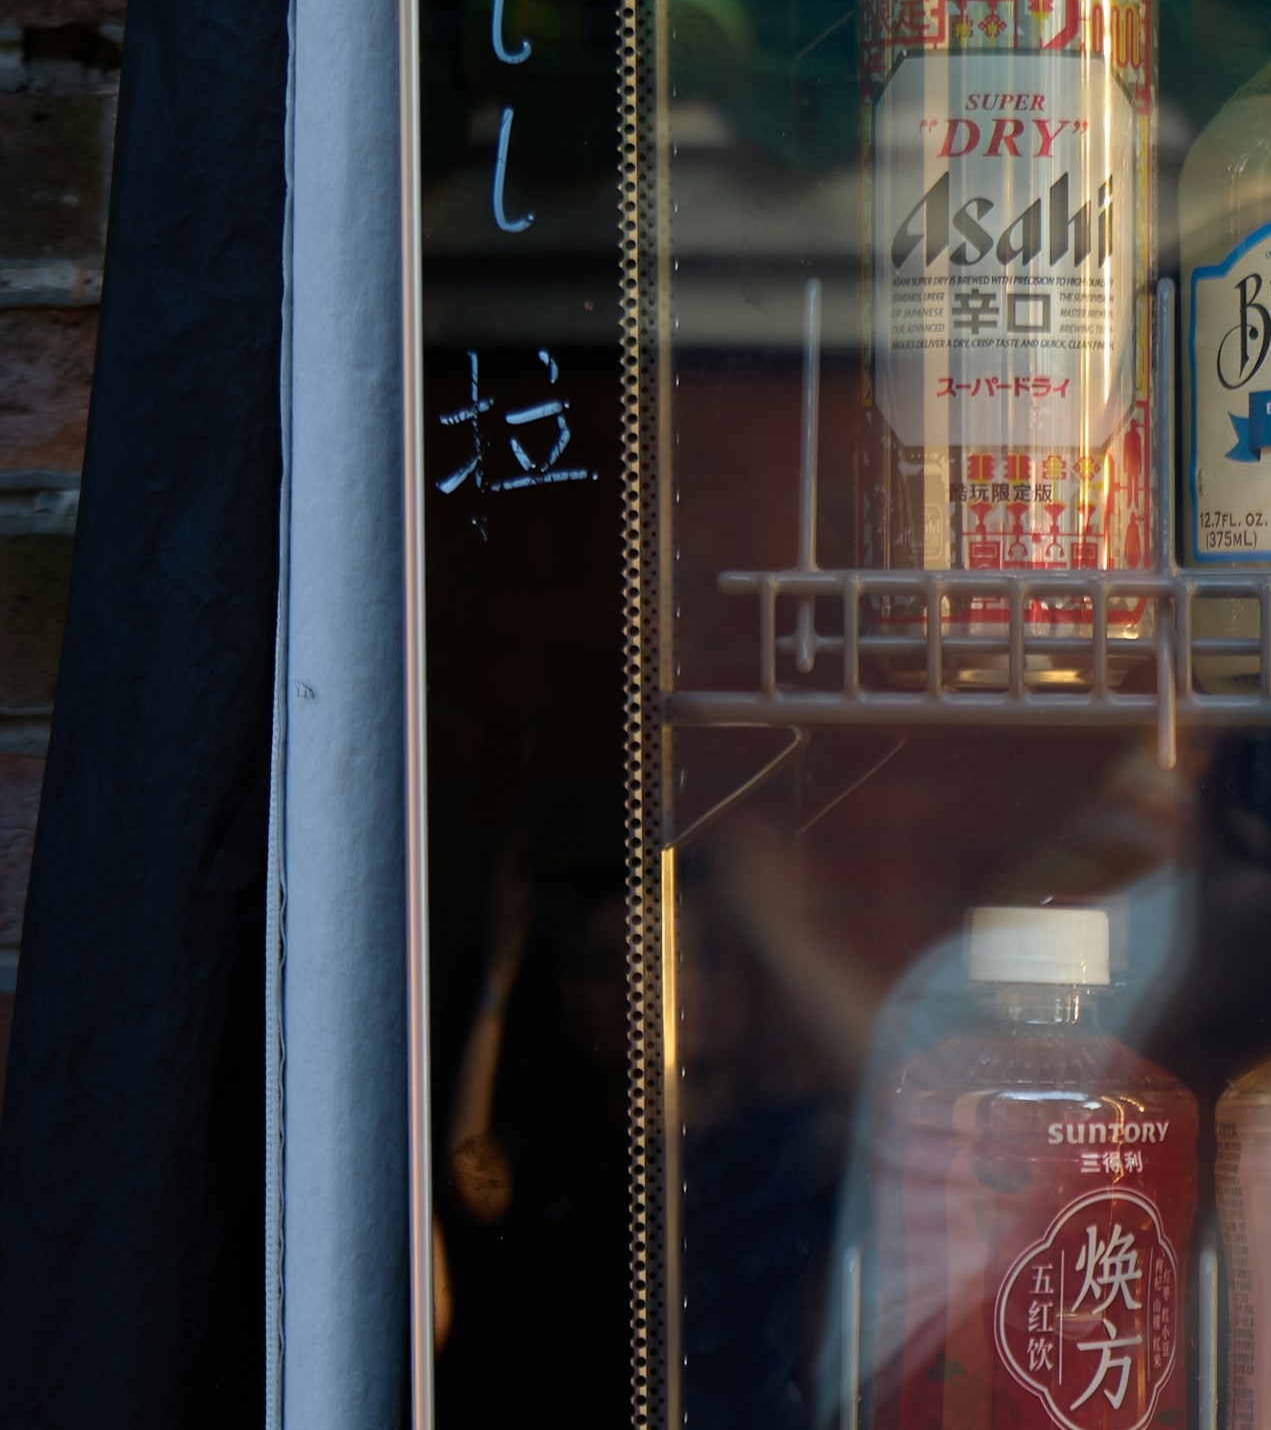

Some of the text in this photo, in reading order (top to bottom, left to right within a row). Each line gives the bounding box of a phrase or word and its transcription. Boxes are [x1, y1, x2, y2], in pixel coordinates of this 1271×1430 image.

[965, 93, 1046, 113] SUPER
[890, 170, 1115, 270] Asahi
[951, 287, 1051, 336] 辛口
[936, 377, 1069, 400] スーパードライ
[948, 483, 1054, 504] 酷玩限定版
[1047, 1121, 1171, 1146] SUNTORY
[1027, 1264, 1055, 1373] 五红饮
[1070, 1222, 1143, 1412] 焕方
